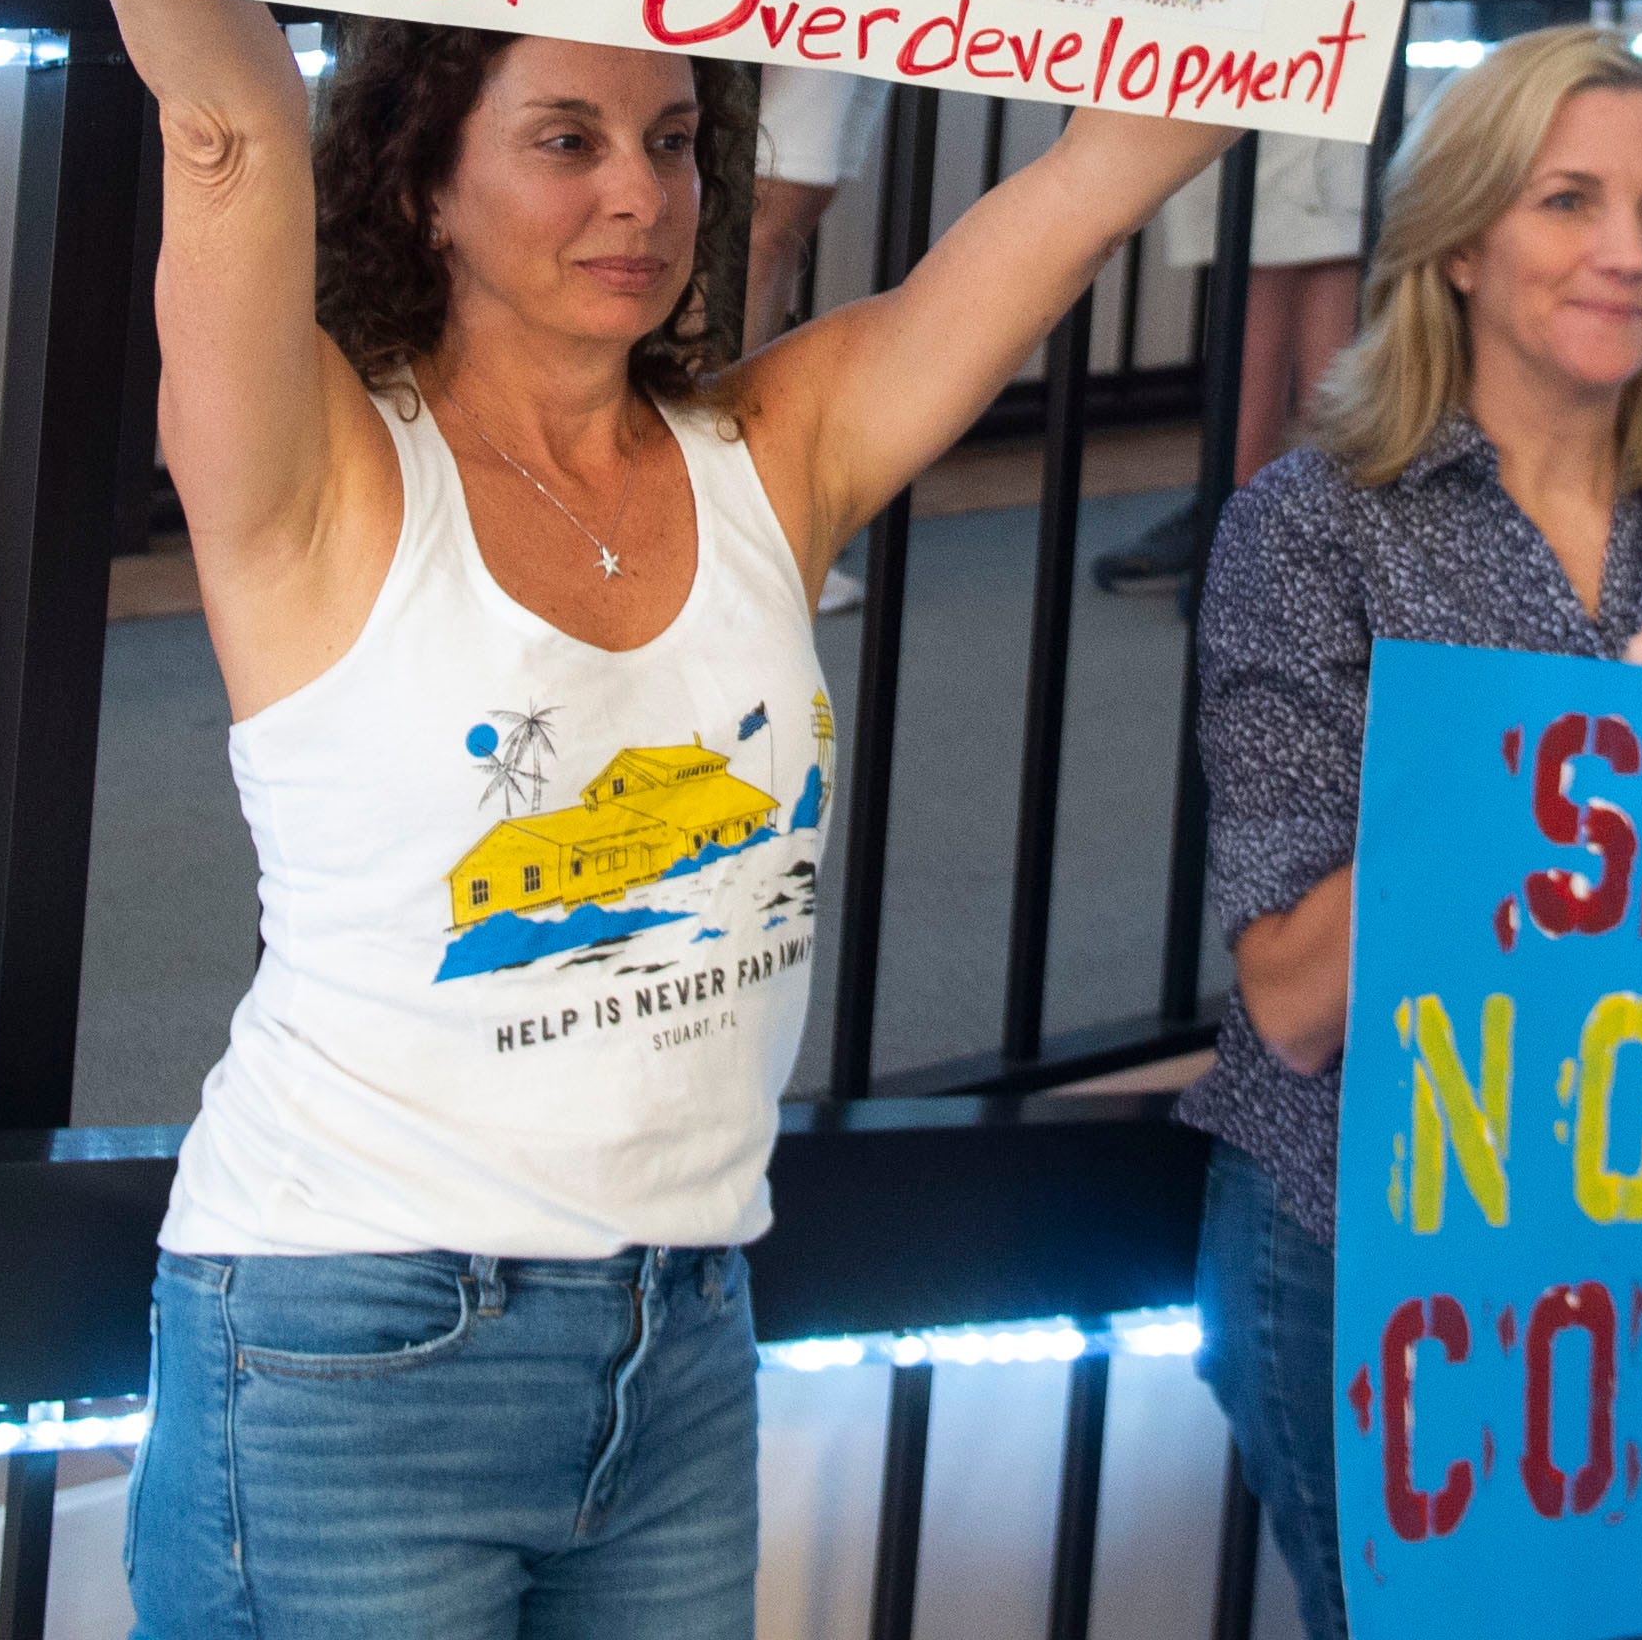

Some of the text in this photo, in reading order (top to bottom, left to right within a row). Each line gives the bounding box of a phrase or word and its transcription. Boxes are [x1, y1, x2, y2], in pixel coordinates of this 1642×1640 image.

[496, 1010, 580, 1053] HELP
[595, 996, 622, 1029] IS
[635, 967, 726, 1019] NEVER
[737, 950, 773, 988] FAR
[720, 1010, 739, 1031] FL
